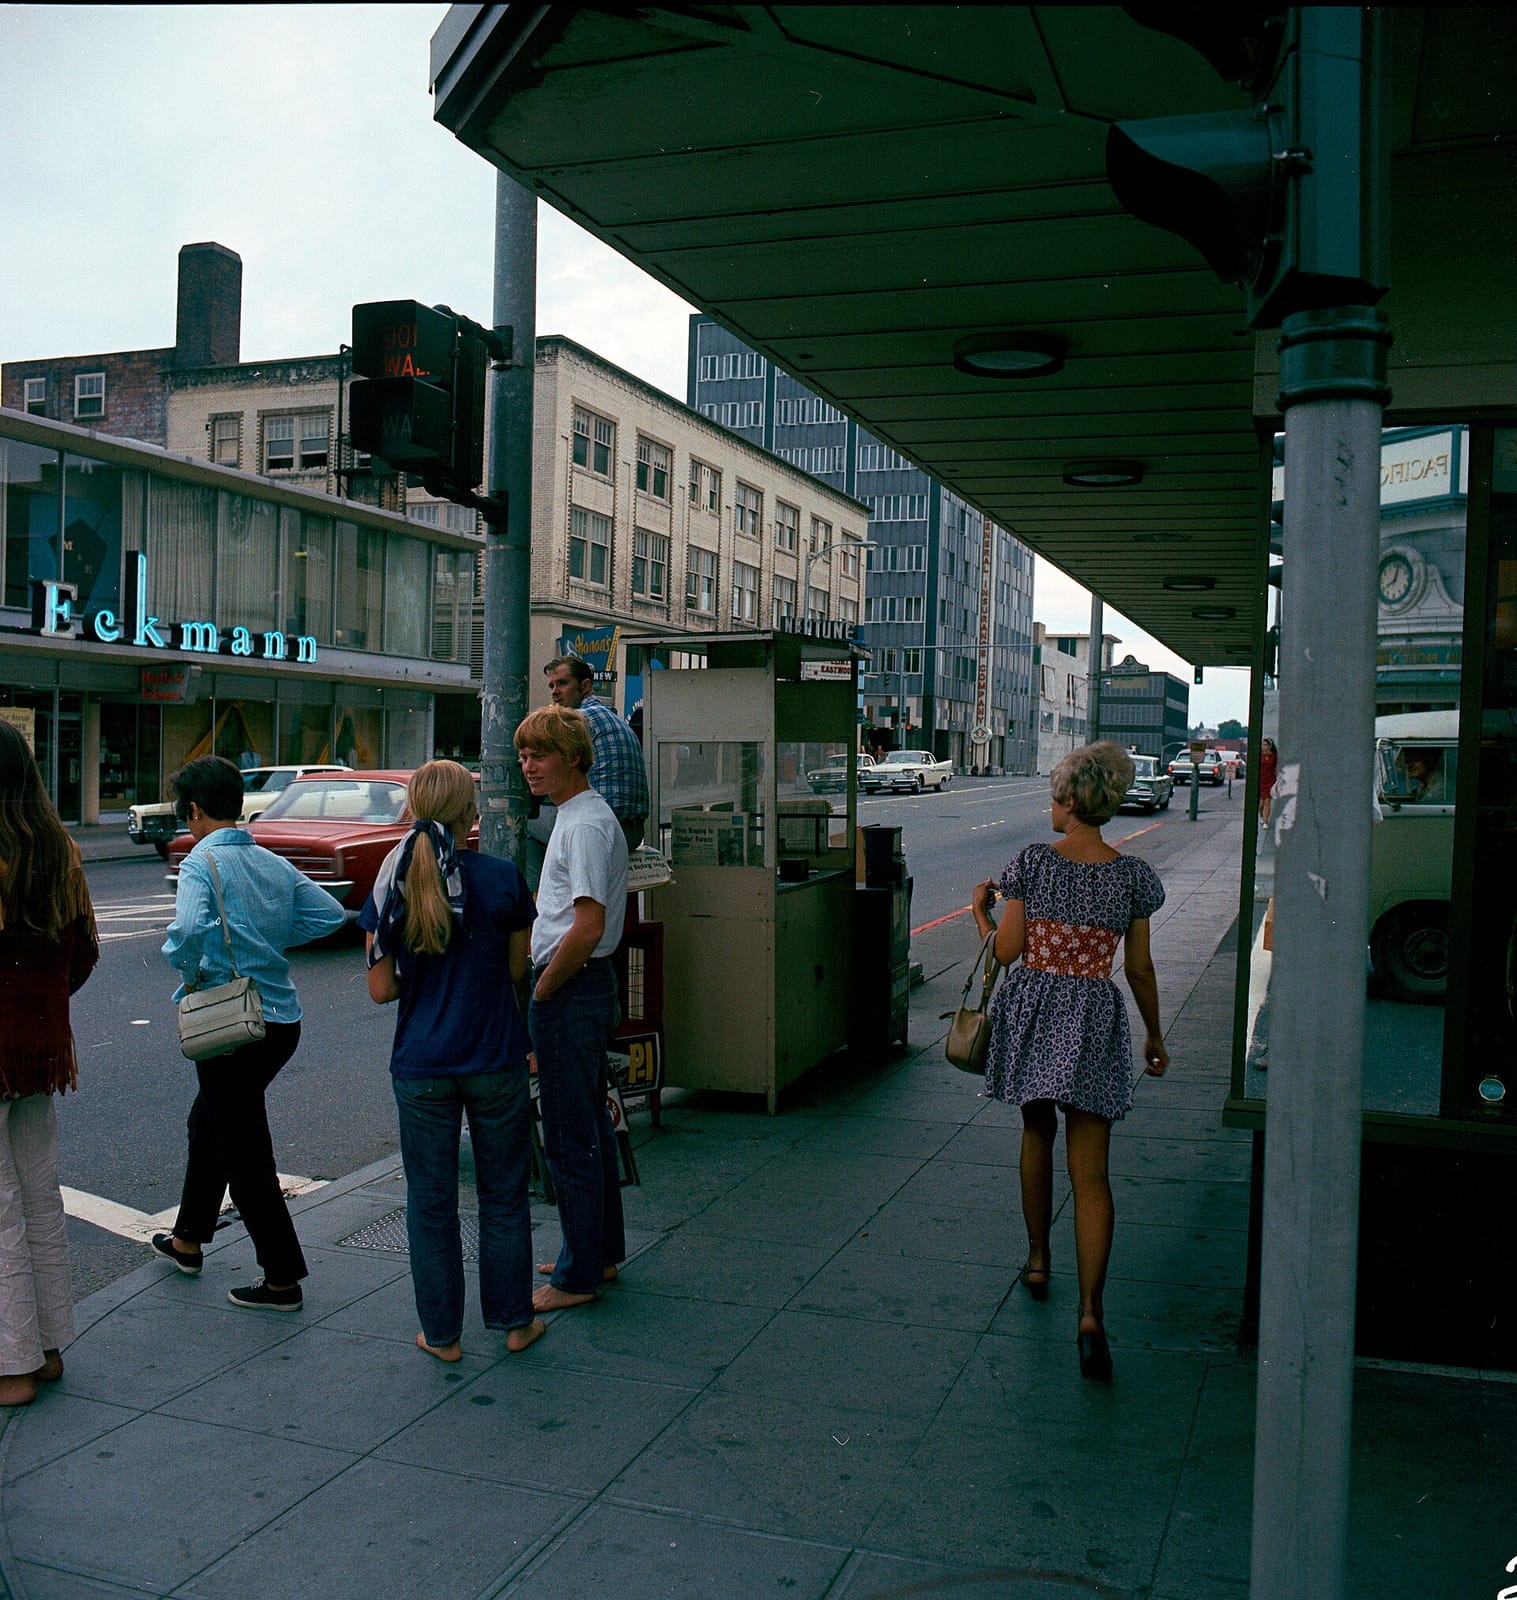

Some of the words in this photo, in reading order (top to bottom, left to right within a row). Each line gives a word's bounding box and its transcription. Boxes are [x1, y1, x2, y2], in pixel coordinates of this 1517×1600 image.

[983, 516, 991, 573] ENERAL
[40, 552, 318, 663] Eckmann
[784, 614, 854, 639] NEPTUNE
[593, 671, 613, 681] NEW
[976, 664, 987, 723] COMPANY
